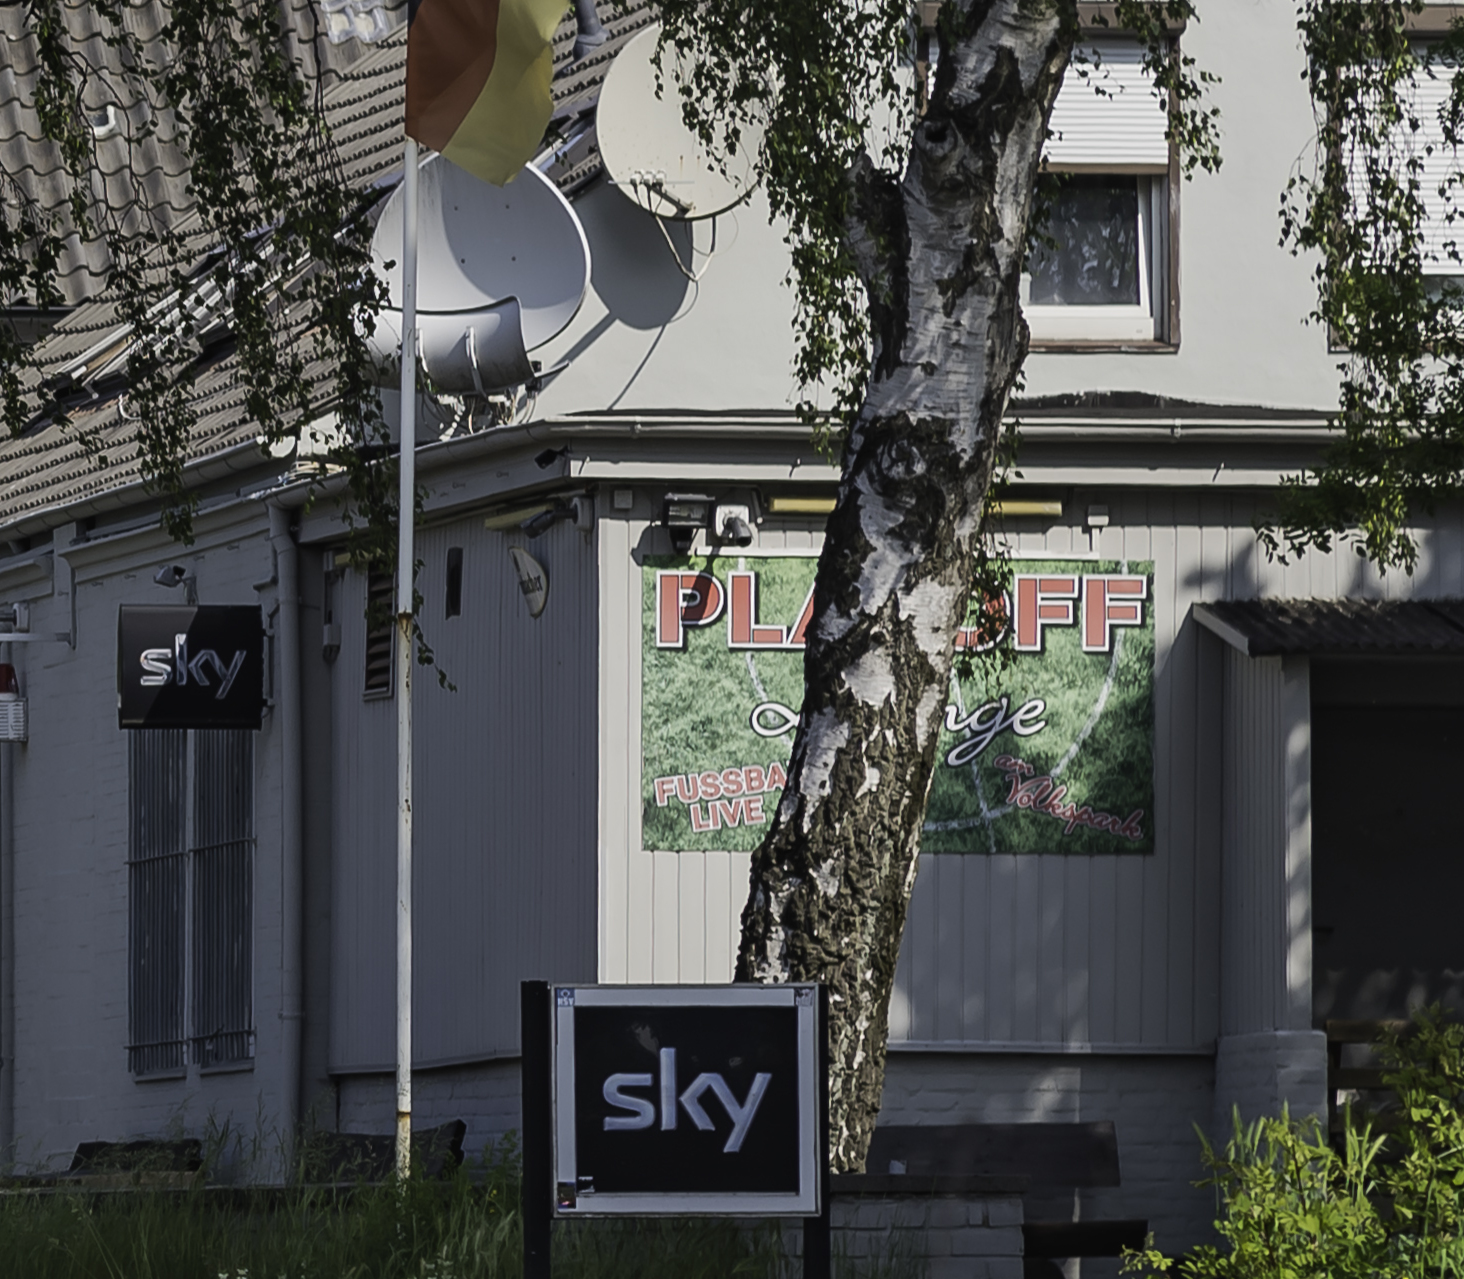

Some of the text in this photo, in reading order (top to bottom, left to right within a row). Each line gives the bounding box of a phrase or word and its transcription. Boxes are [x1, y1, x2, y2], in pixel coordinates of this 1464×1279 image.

[140, 633, 247, 699] sky
[654, 762, 787, 807] FUSSBA
[689, 795, 766, 833] LIVE
[1005, 773, 1144, 841] Volkspark
[602, 1046, 773, 1153] sky
